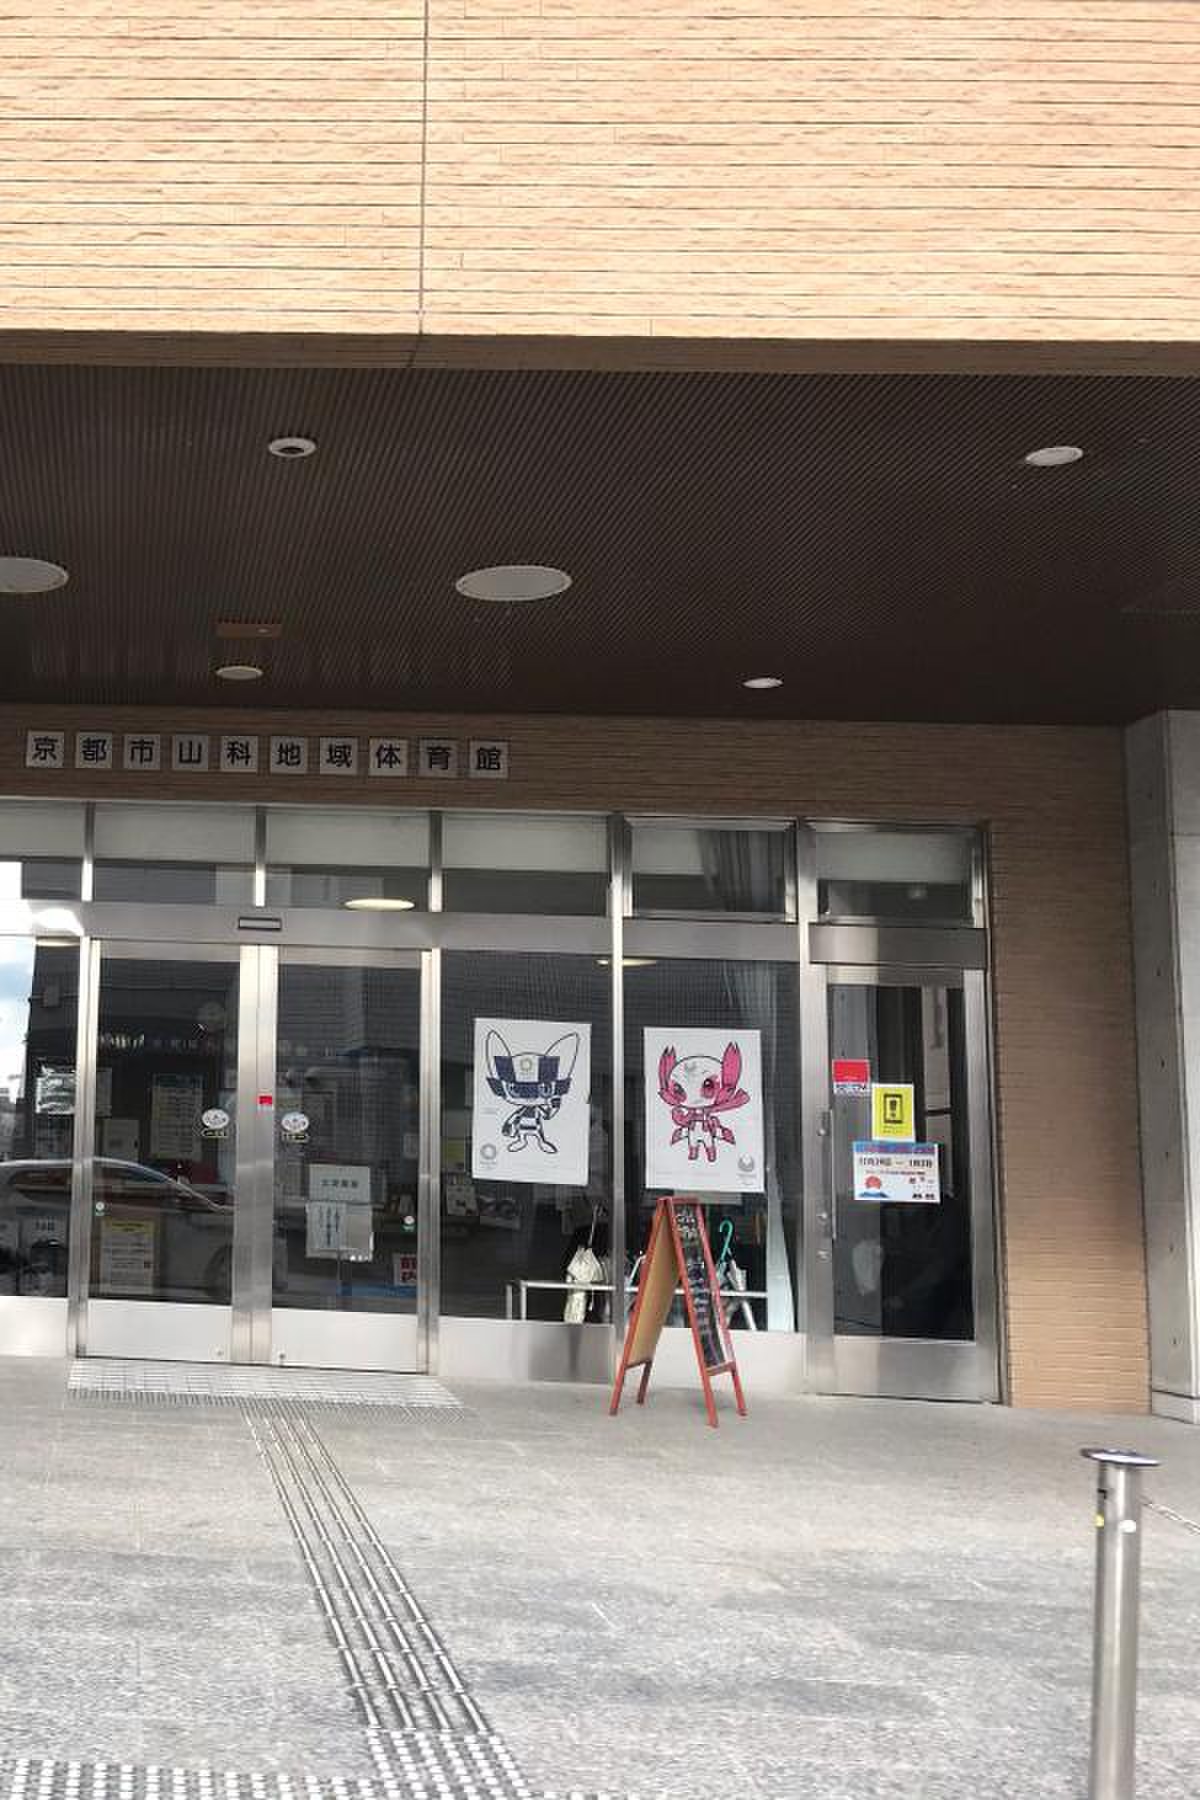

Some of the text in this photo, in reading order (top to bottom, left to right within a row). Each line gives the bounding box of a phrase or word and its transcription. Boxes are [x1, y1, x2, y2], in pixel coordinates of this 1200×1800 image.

[31, 735, 503, 772] 京都市山科地域体育館
